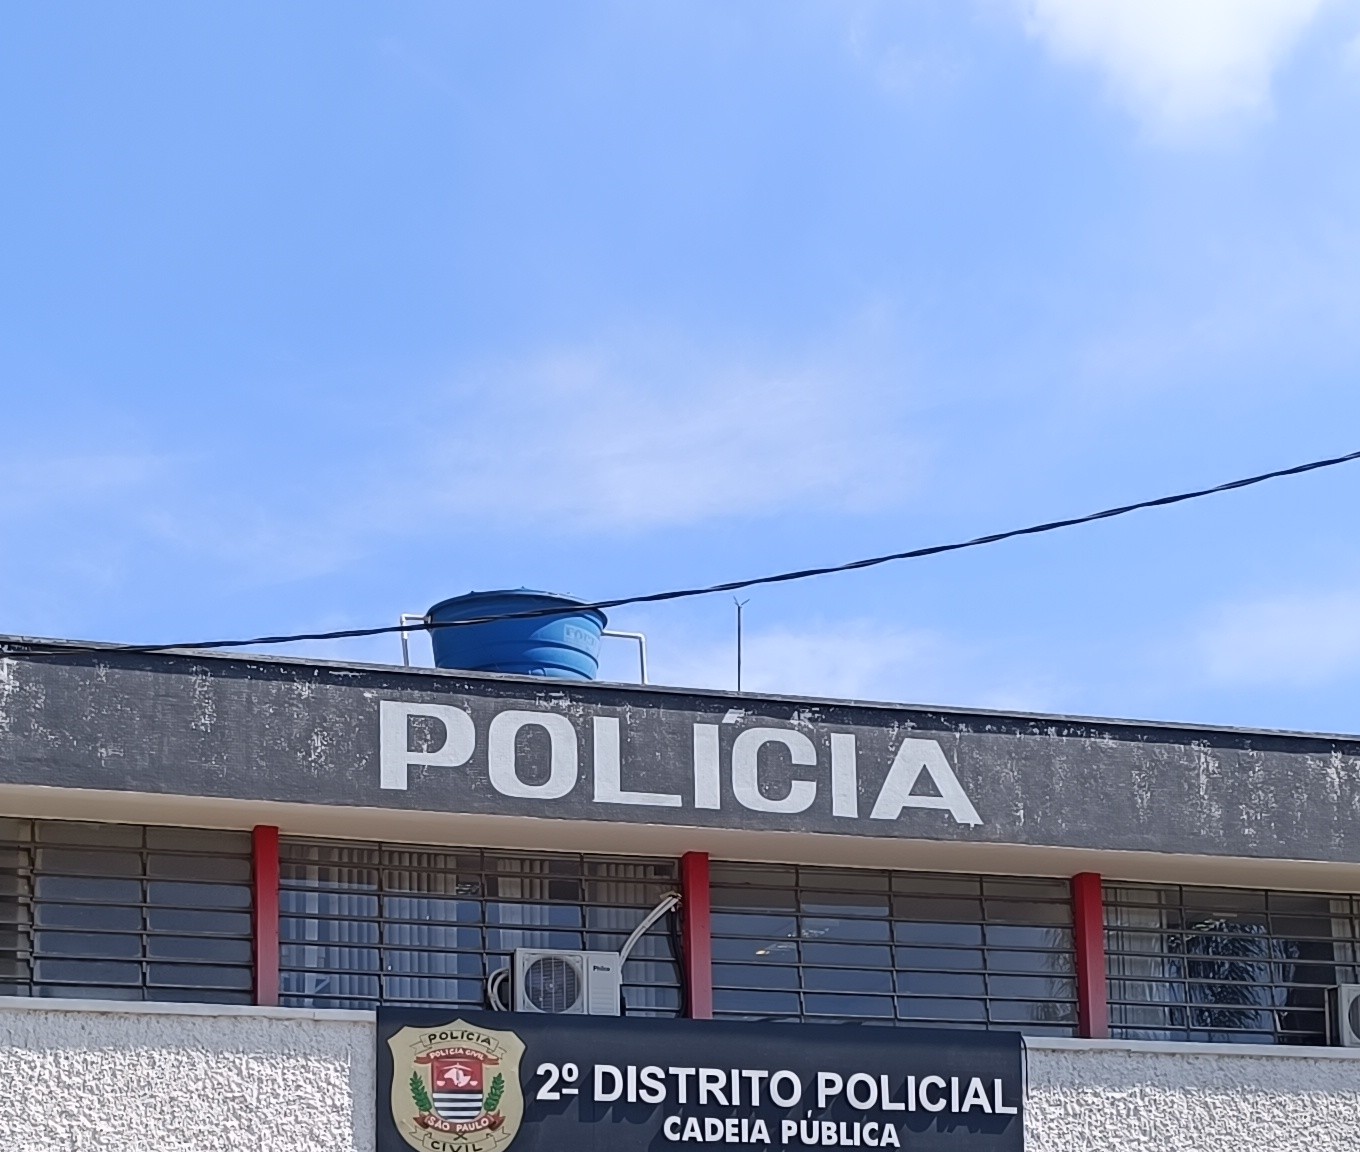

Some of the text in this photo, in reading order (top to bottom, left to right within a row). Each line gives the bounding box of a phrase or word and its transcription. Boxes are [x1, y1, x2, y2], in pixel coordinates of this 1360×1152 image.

[378, 699, 983, 826] POLÍCIA
[428, 1030, 491, 1046] POLÍCIA
[465, 1049, 485, 1061] CIVIL
[593, 1064, 802, 1108] DISTRITO
[818, 1071, 1018, 1115] POLICIAL
[456, 1117, 489, 1133] PAULO
[663, 1108, 901, 1148] CADEIA PÚBLICA
